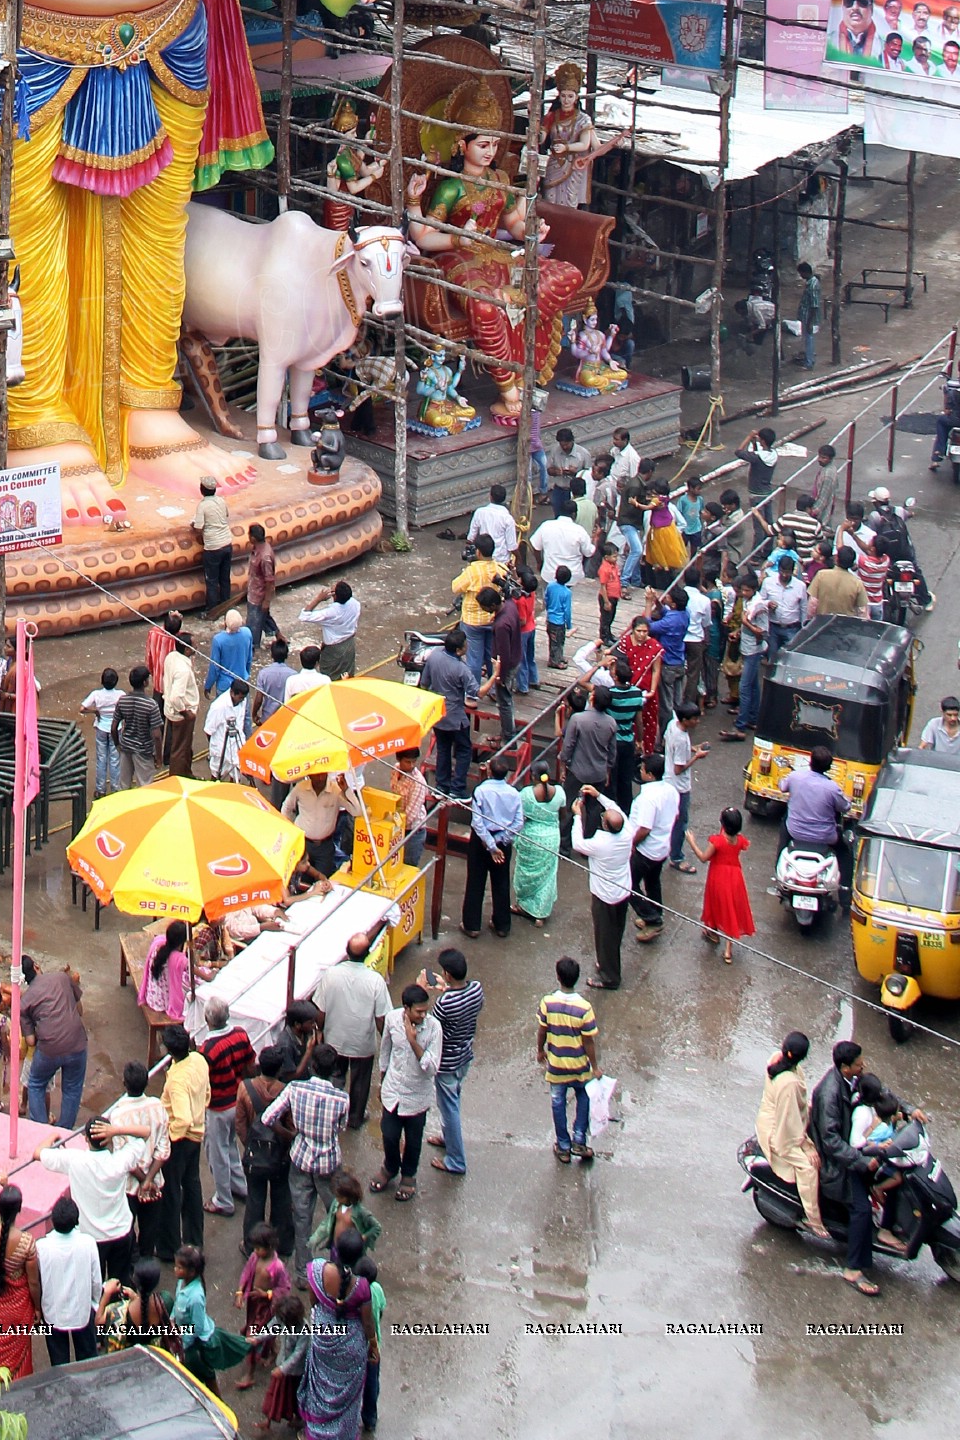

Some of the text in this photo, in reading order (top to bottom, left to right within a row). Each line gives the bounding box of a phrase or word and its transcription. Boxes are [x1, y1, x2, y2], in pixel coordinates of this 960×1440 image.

[603, 4, 640, 19] MONEY
[626, 29, 651, 39] TRANSFER
[12, 466, 57, 481] COMMITTEE
[10, 477, 47, 489] Counter
[41, 528, 60, 536] Founder
[387, 738, 405, 750] FM
[251, 889, 271, 900] FM
[171, 904, 190, 913] FM
